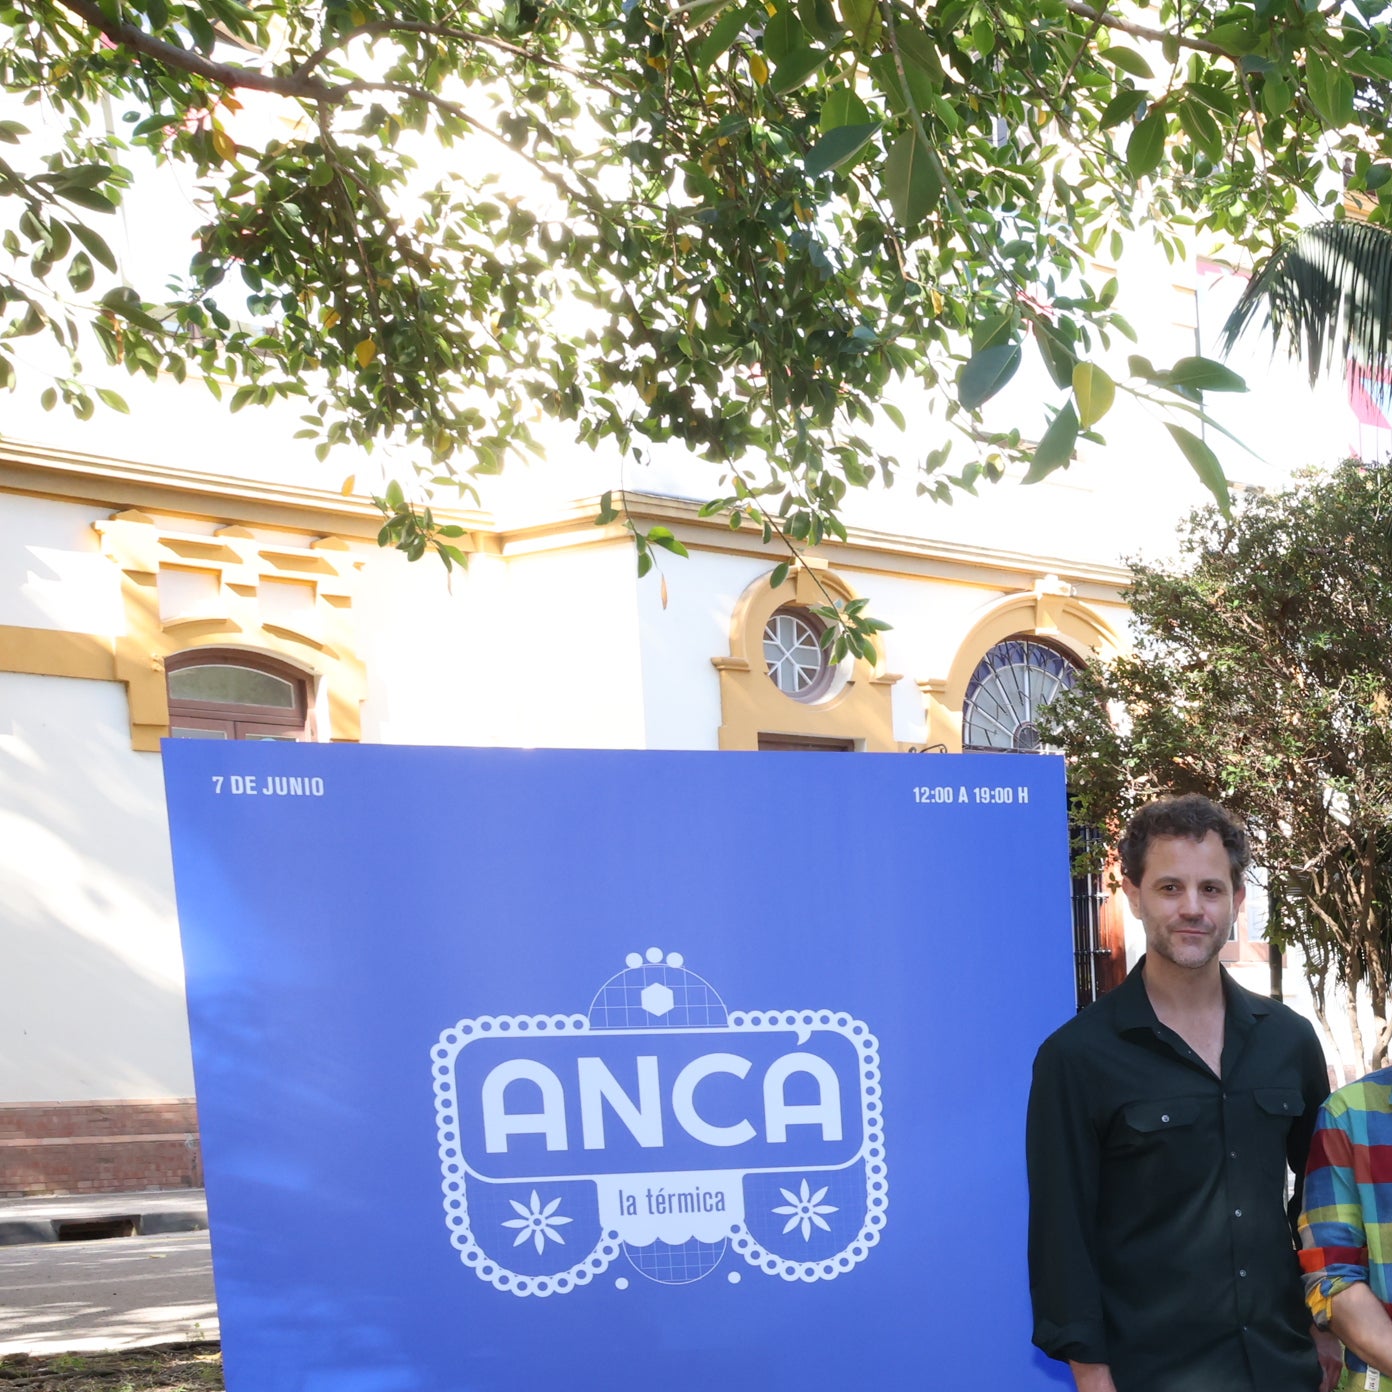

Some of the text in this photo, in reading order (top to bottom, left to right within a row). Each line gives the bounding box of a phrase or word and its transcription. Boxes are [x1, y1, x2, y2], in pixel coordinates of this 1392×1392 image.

[212, 775, 325, 796] 7 DE JUNIO
[913, 785, 1029, 804] 12:00 A 19:00 H
[618, 1186, 726, 1216] la térmica
